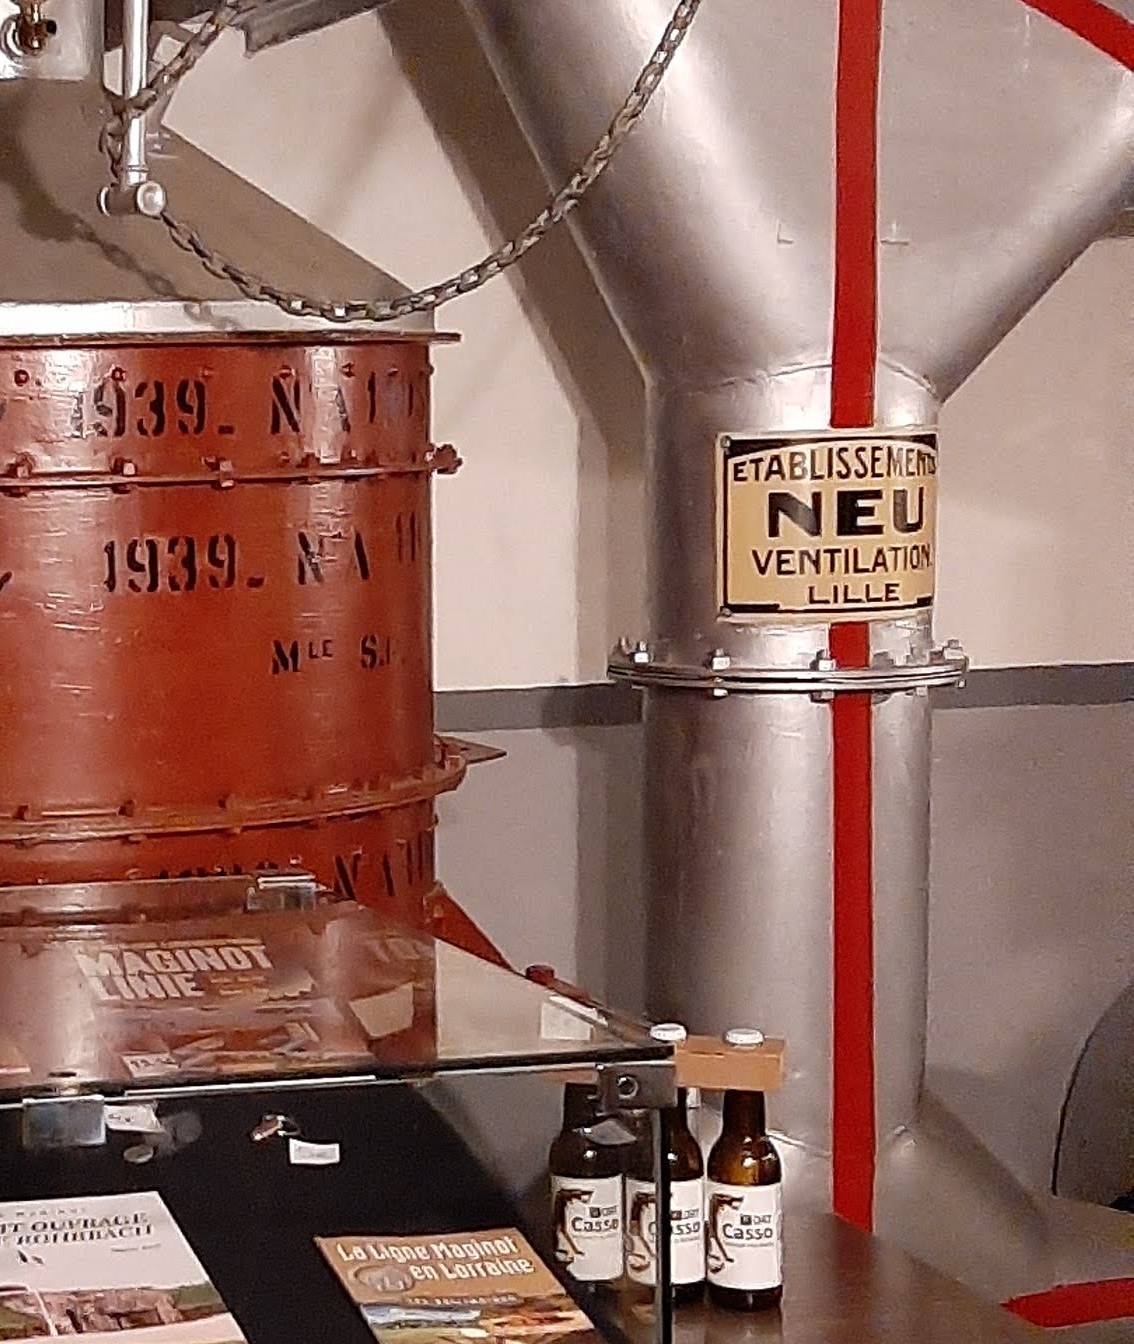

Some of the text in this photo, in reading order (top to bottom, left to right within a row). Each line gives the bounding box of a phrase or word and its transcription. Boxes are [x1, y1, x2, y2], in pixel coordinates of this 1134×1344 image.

[768, 487, 924, 538] NEU
[808, 583, 900, 604] LILLE
[74, 945, 274, 976] MAGINOT
[91, 973, 206, 1000] LINIE
[571, 1217, 619, 1232] Casso
[723, 1223, 773, 1240] Casso
[337, 1235, 520, 1264] La Ligne Maginot
[409, 1258, 536, 1281] en Lorraine
